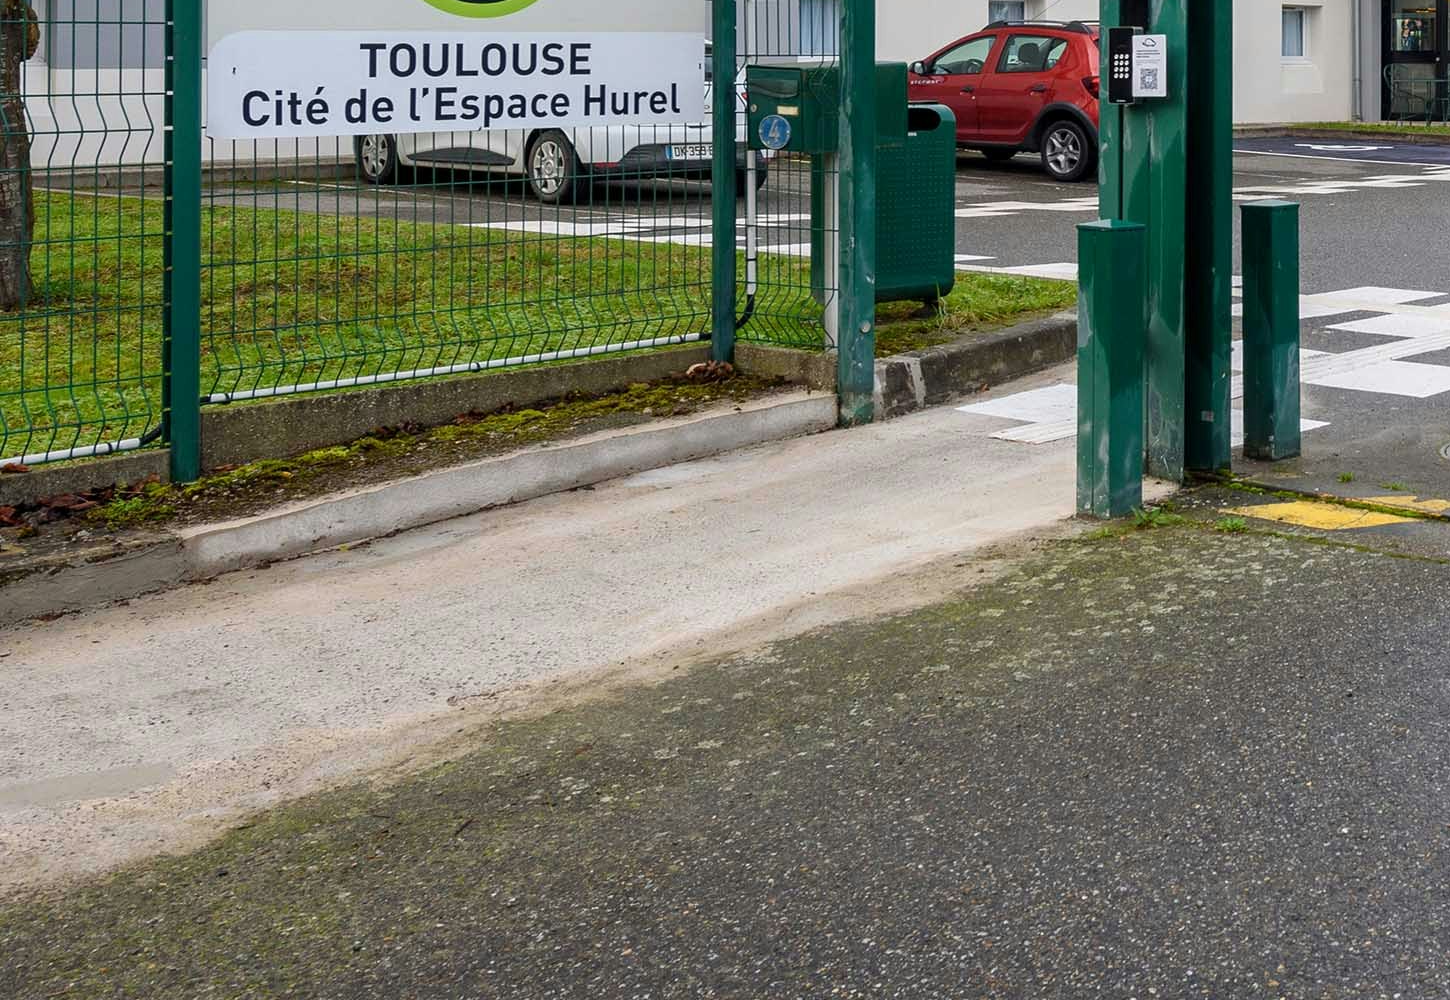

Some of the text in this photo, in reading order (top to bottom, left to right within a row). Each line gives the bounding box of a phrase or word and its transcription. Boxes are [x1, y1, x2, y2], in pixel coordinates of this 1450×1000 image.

[360, 42, 592, 78] TOULOUSE
[242, 82, 681, 128] Cité de l'Espace Hurel
